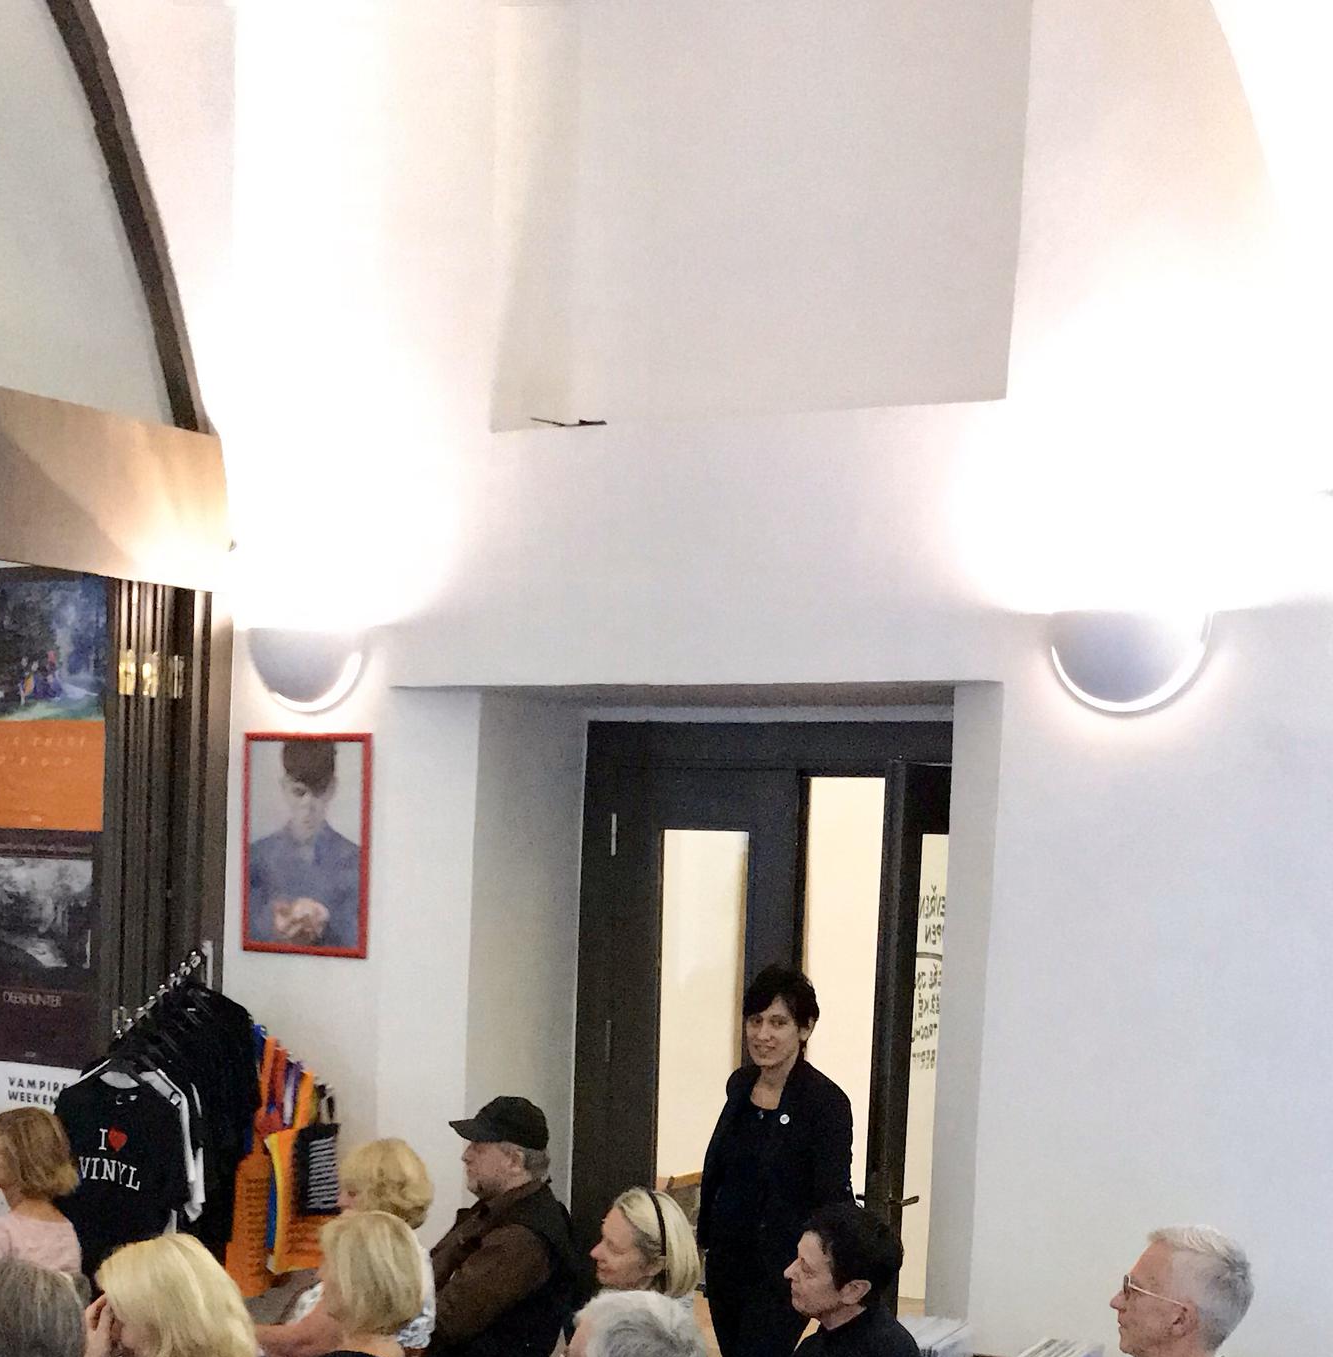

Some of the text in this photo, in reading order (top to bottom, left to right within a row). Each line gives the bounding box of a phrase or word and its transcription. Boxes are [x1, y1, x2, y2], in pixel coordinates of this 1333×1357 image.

[7, 1090, 57, 1105] WEEKEN
[98, 1128, 109, 1151] I
[78, 1155, 141, 1191] VINYL
